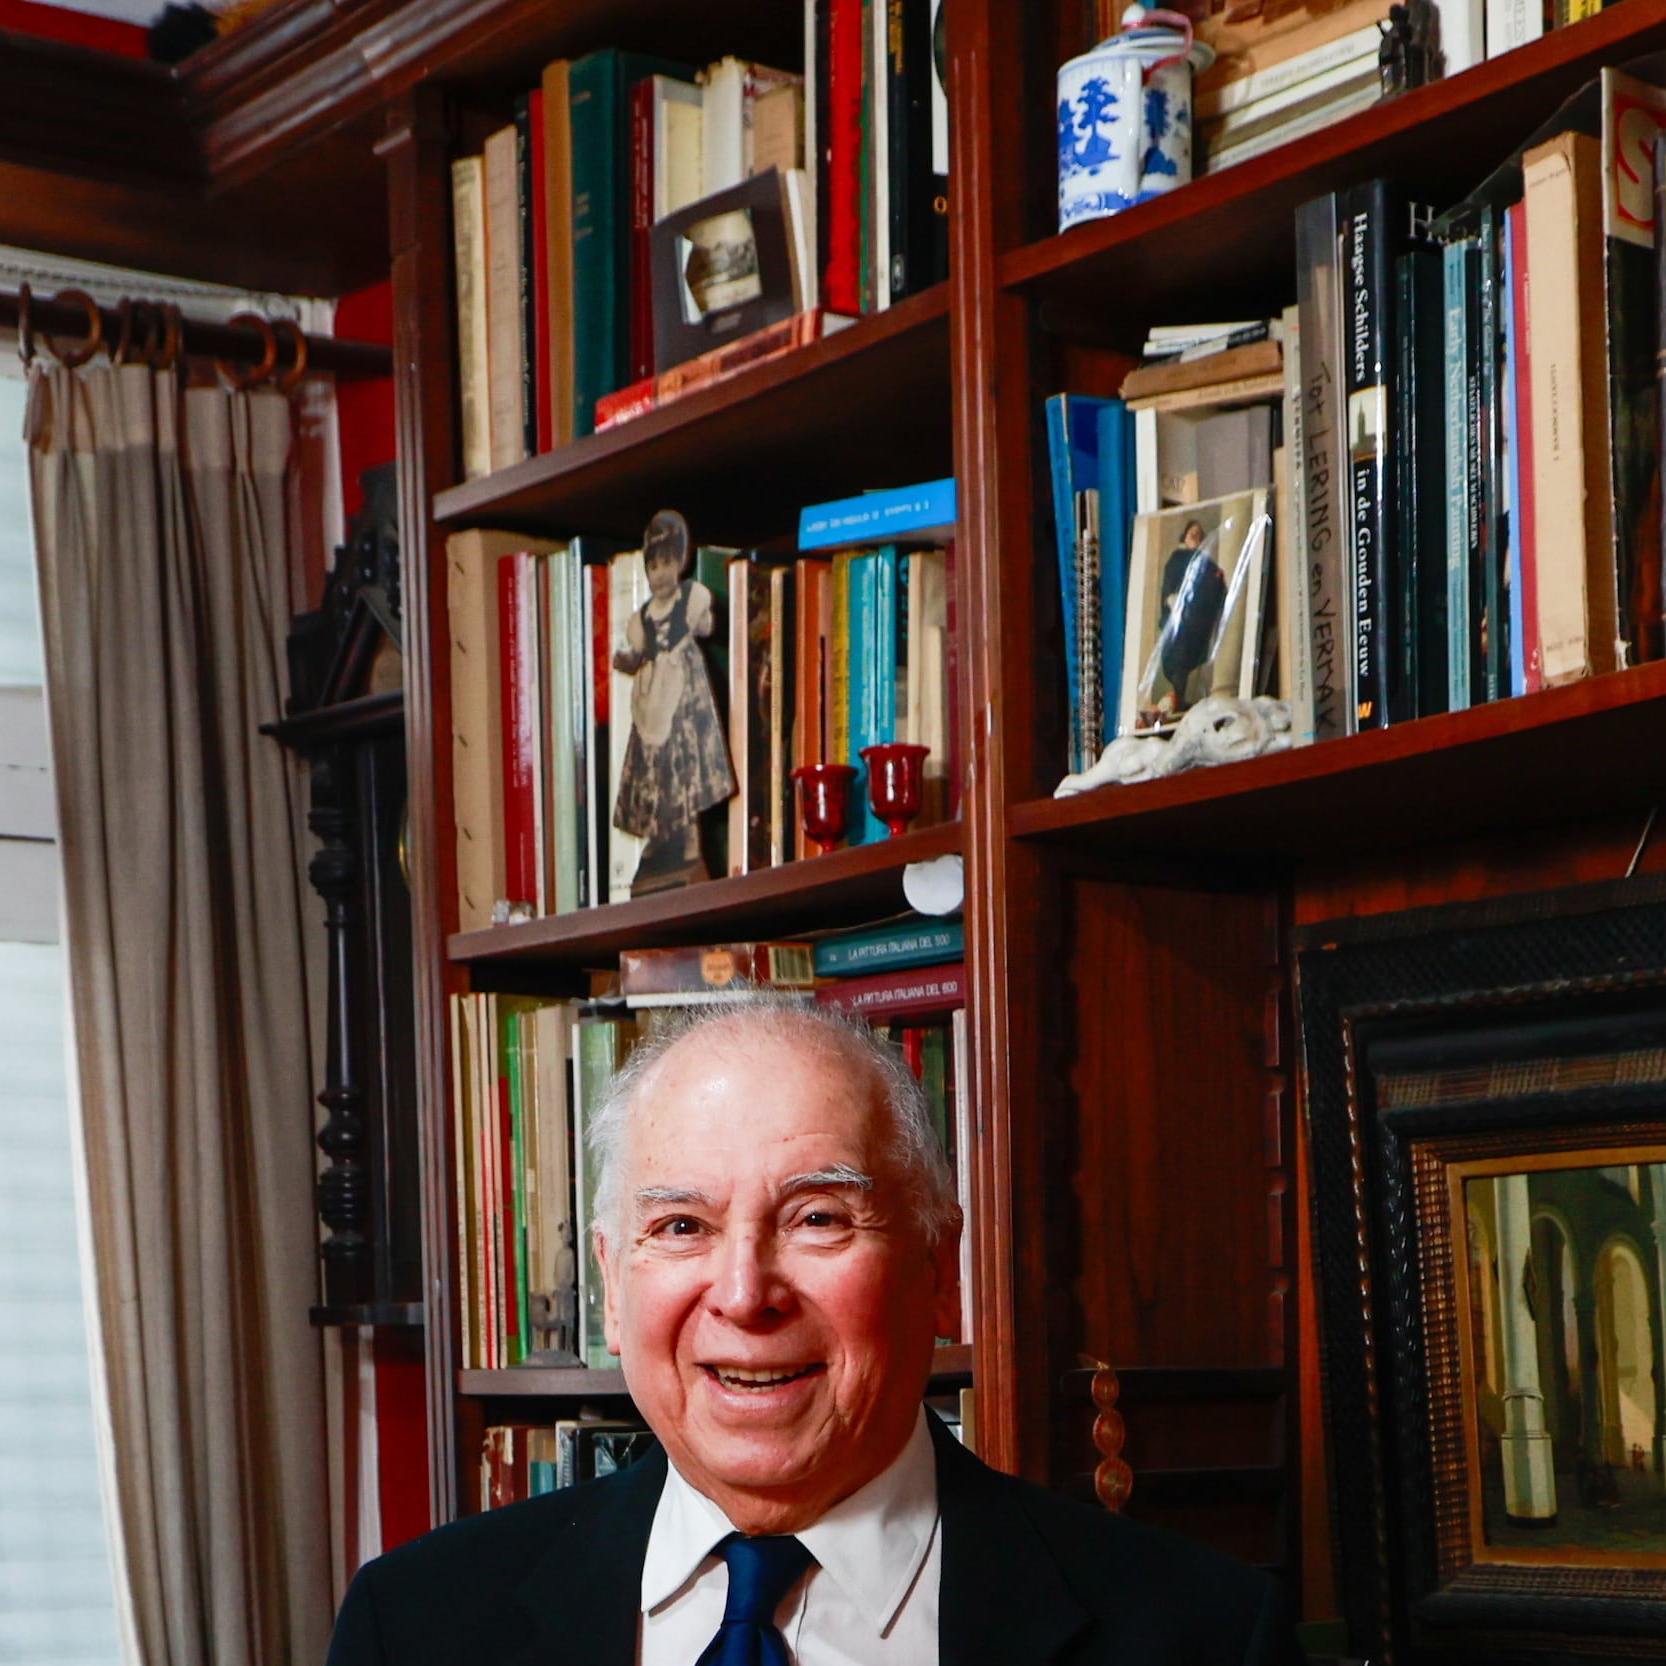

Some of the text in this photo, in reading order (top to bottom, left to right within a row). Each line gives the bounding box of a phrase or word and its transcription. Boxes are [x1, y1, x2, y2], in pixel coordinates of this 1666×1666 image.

[1350, 211, 1372, 384] Haagse Schilders
[1445, 308, 1467, 572] Early Netherlandish Painting
[1308, 360, 1340, 733] Tot LERING en VERMAK
[1356, 468, 1375, 678] in de Gouden Eeuw
[918, 934, 934, 950] DEL
[925, 981, 941, 997] DEL
